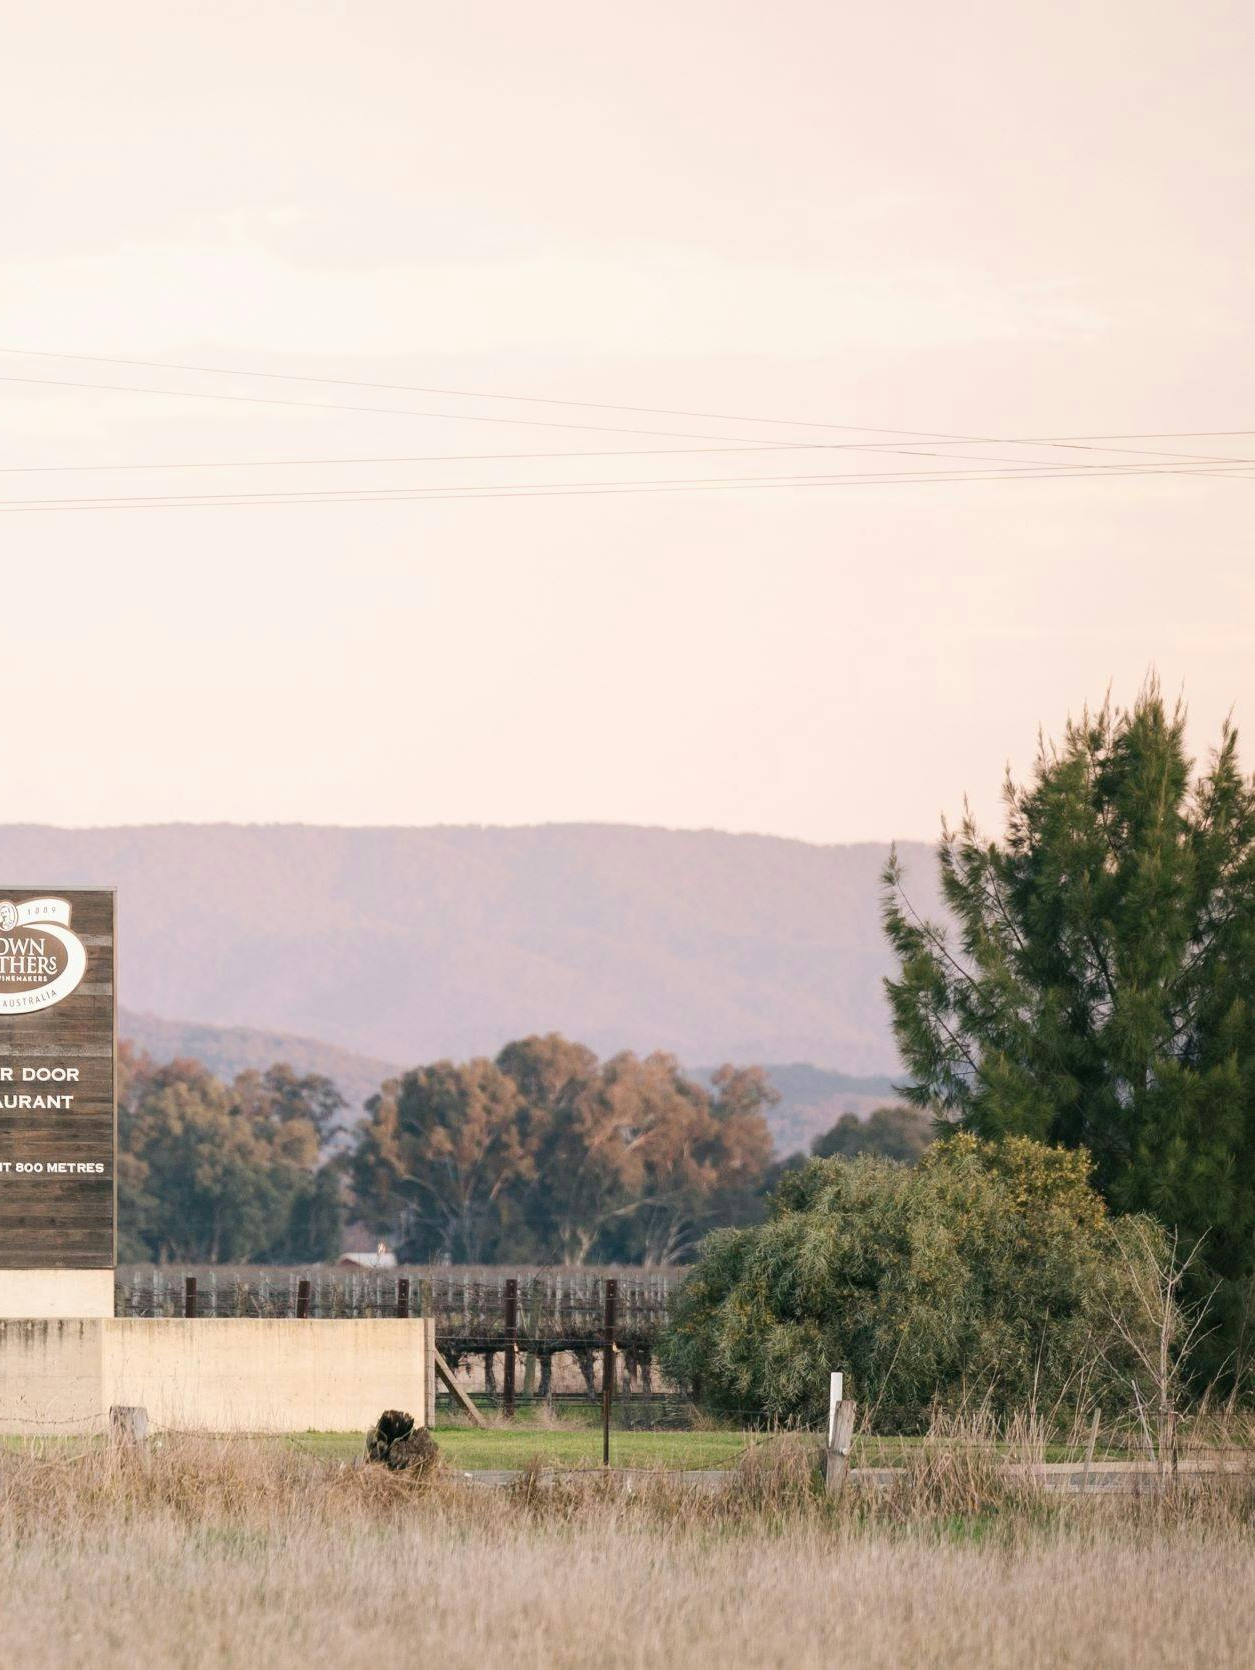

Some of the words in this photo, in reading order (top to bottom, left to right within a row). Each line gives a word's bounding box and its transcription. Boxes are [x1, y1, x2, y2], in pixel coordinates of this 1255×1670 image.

[2, 989, 58, 1007] AUSTRALIA
[22, 1067, 80, 1082] DOOR
[15, 1162, 44, 1173] 800
[46, 1162, 105, 1174] METRES
